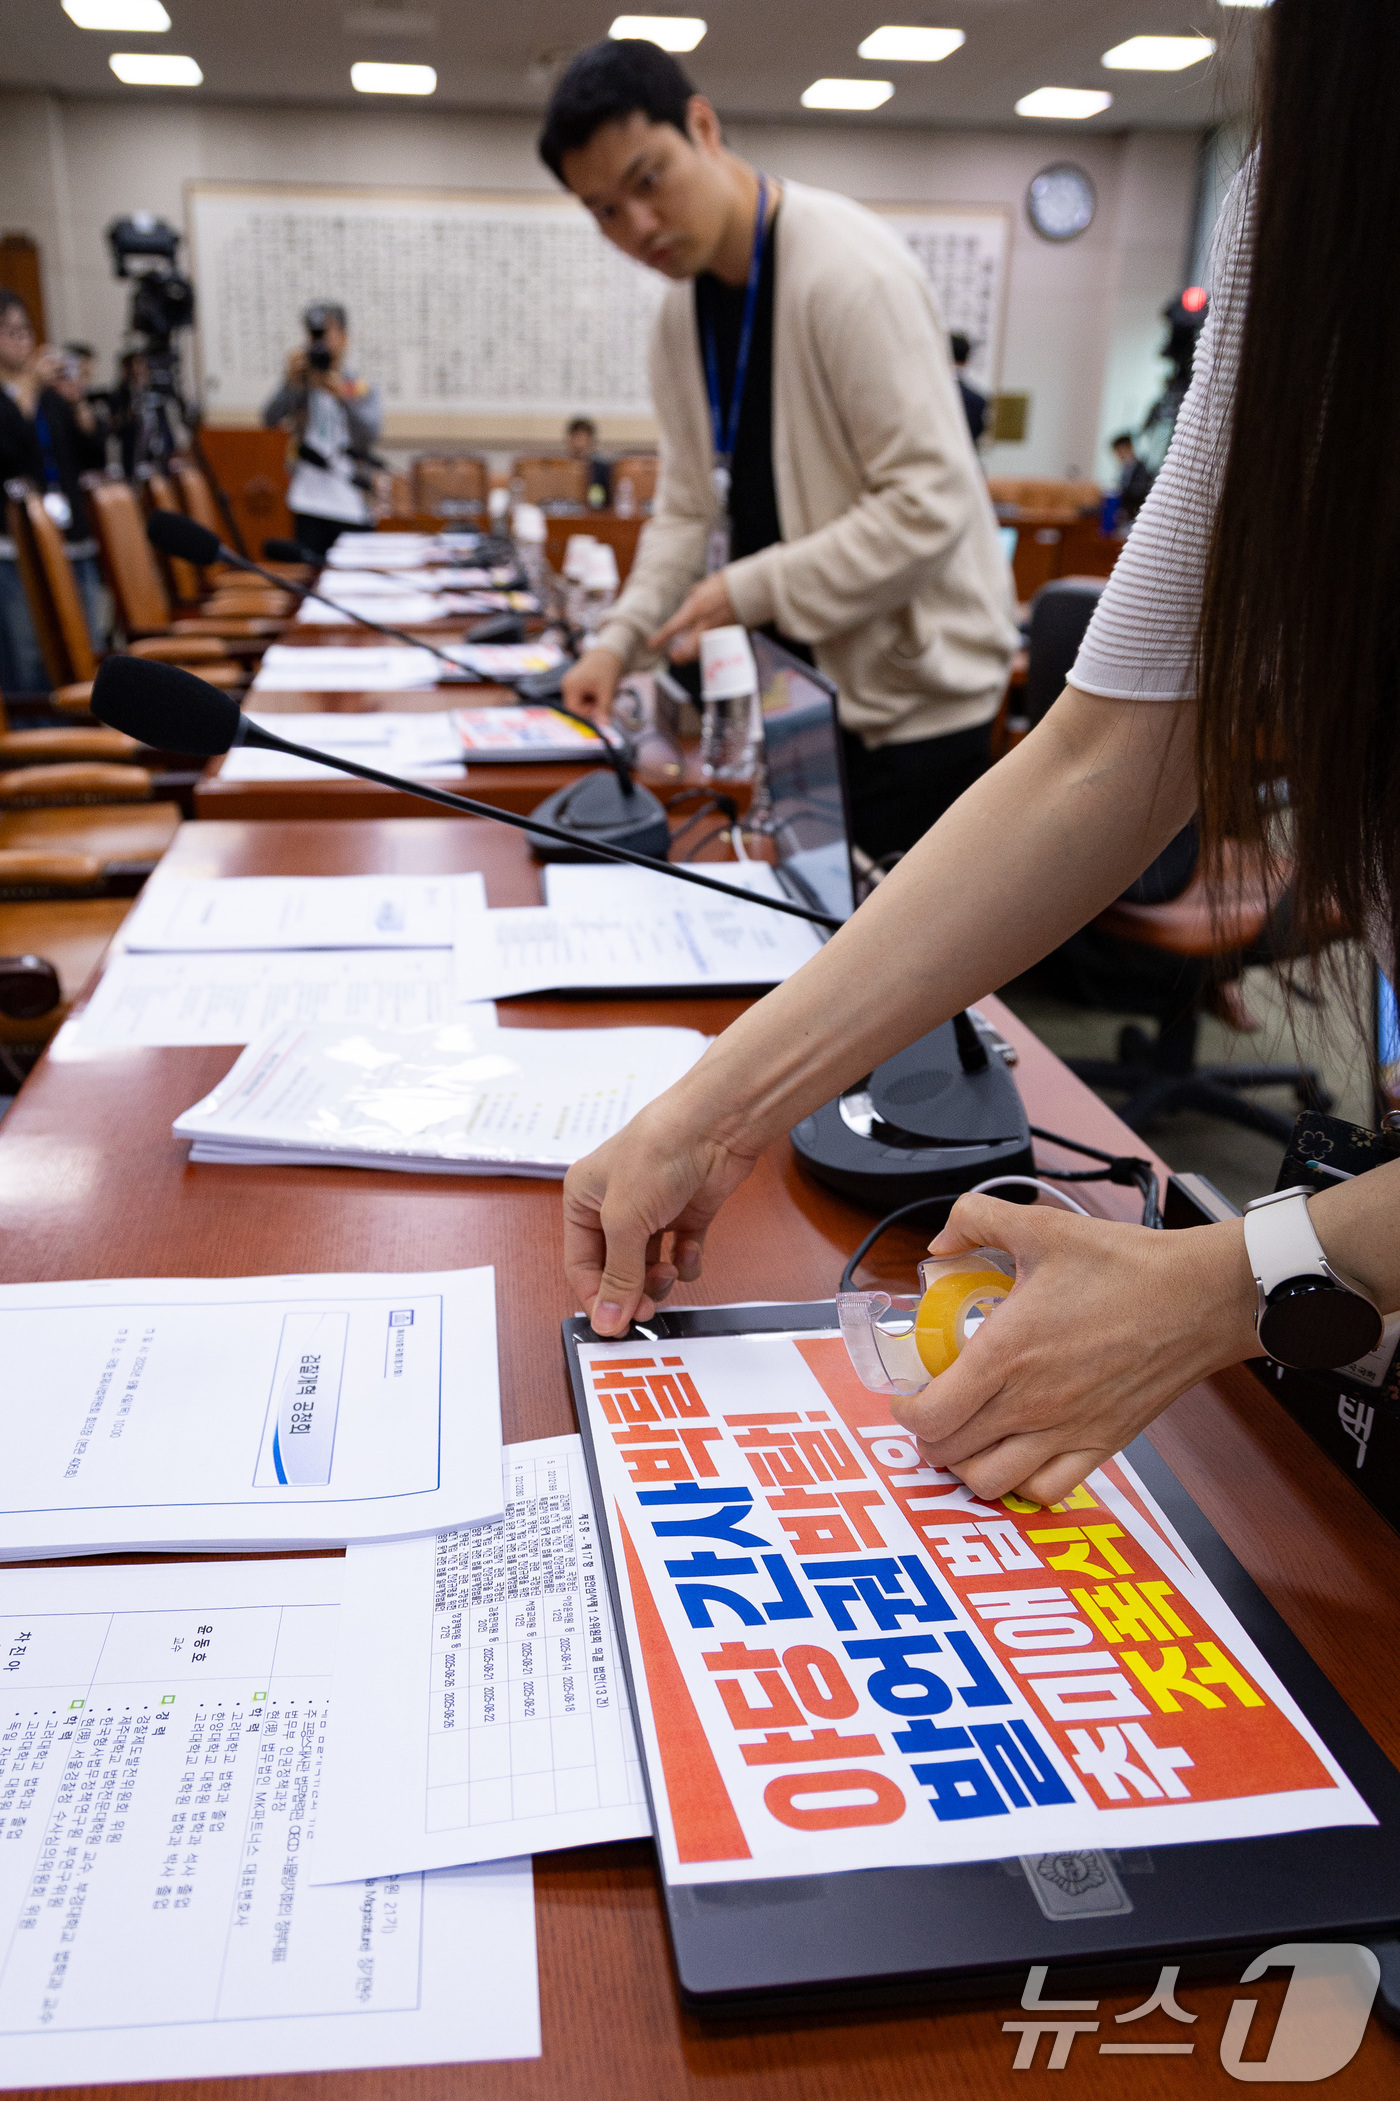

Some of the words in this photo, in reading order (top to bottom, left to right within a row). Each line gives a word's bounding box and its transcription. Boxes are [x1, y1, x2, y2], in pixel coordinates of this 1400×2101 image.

[296, 1354, 321, 1395] 검찰개혁
[110, 1420, 126, 1438] 10:00
[288, 1402, 315, 1434] 공청회
[451, 1612, 462, 1640] 장경태의원
[478, 1620, 488, 1632] 20인
[488, 1606, 499, 1634] 김용민의원
[515, 1614, 525, 1627] 12인
[552, 1608, 562, 1622] 12인
[723, 1412, 1075, 1821] 발언권박탈!
[1026, 1524, 1265, 1713] 조폭식
[170, 1637, 184, 1652] 교수
[440, 1626, 450, 1639] 27인
[484, 1648, 494, 1681] 2025-08-21
[522, 1642, 533, 1675] 2025-08-21
[560, 1637, 572, 1671] 2025-08-14
[592, 1648, 604, 1662] 의결
[444, 1654, 456, 1688] 2025-08-26
[484, 1687, 494, 1722] 2025-08-22
[523, 1681, 535, 1716] 2025-08-22
[563, 1676, 575, 1712] 2025-08-18
[967, 1587, 1194, 1799] 추미애
[282, 1710, 298, 1739] 법무부
[304, 1710, 318, 1718] 주
[443, 1692, 455, 1728] 2025-08-26
[2, 1722, 21, 1741] 독일
[12, 1721, 40, 1772] 고려대학교
[31, 1720, 58, 1771] 고려대학교
[109, 1716, 132, 1764] 제주대학교
[185, 1713, 207, 1766] 고려대학교
[204, 1712, 225, 1765] 한양대학교
[223, 1712, 243, 1764] 고려대학교
[296, 1722, 315, 1772] 프랑스대사관
[702, 1642, 905, 1830] 야당
[57, 1750, 86, 1804] 서울경찰청
[68, 1717, 114, 1838] 한국형사법무정책연구원
[114, 1715, 151, 1813] 경찰제도발전위원회
[256, 1743, 276, 1786] 법무법인
[272, 1747, 294, 1811] 인권정책과장
[16, 1778, 40, 1810] 법학과
[175, 1772, 195, 1805] 대학원
[194, 1771, 214, 1804] 대학원
[215, 1771, 234, 1803] 법학과
[86, 1770, 118, 1845] 법학전문대학원
[209, 1810, 227, 1832] 졸업
[6, 1817, 27, 1839] 졸업
[106, 1820, 125, 1843] 위원
[167, 1813, 187, 1846] 법학과
[186, 1811, 207, 1845] 법학과
[246, 1792, 268, 1857] MK파트너스
[287, 1826, 301, 1852] OECD
[30, 1811, 67, 1897] 수사심의위원회
[160, 1853, 179, 1877] 박사
[181, 1853, 199, 1876] 석사
[47, 1846, 79, 1908] 부연구위원
[152, 1885, 172, 1909] 졸업
[173, 1884, 194, 1908] 졸업
[234, 1864, 257, 1926] 대표변호사
[19, 1905, 41, 1929] 위원
[60, 1882, 88, 1943] 부경대학교
[380, 1902, 398, 1934] 21기)
[47, 1950, 71, 1990] 법학과
[39, 1998, 59, 2024] 교수
